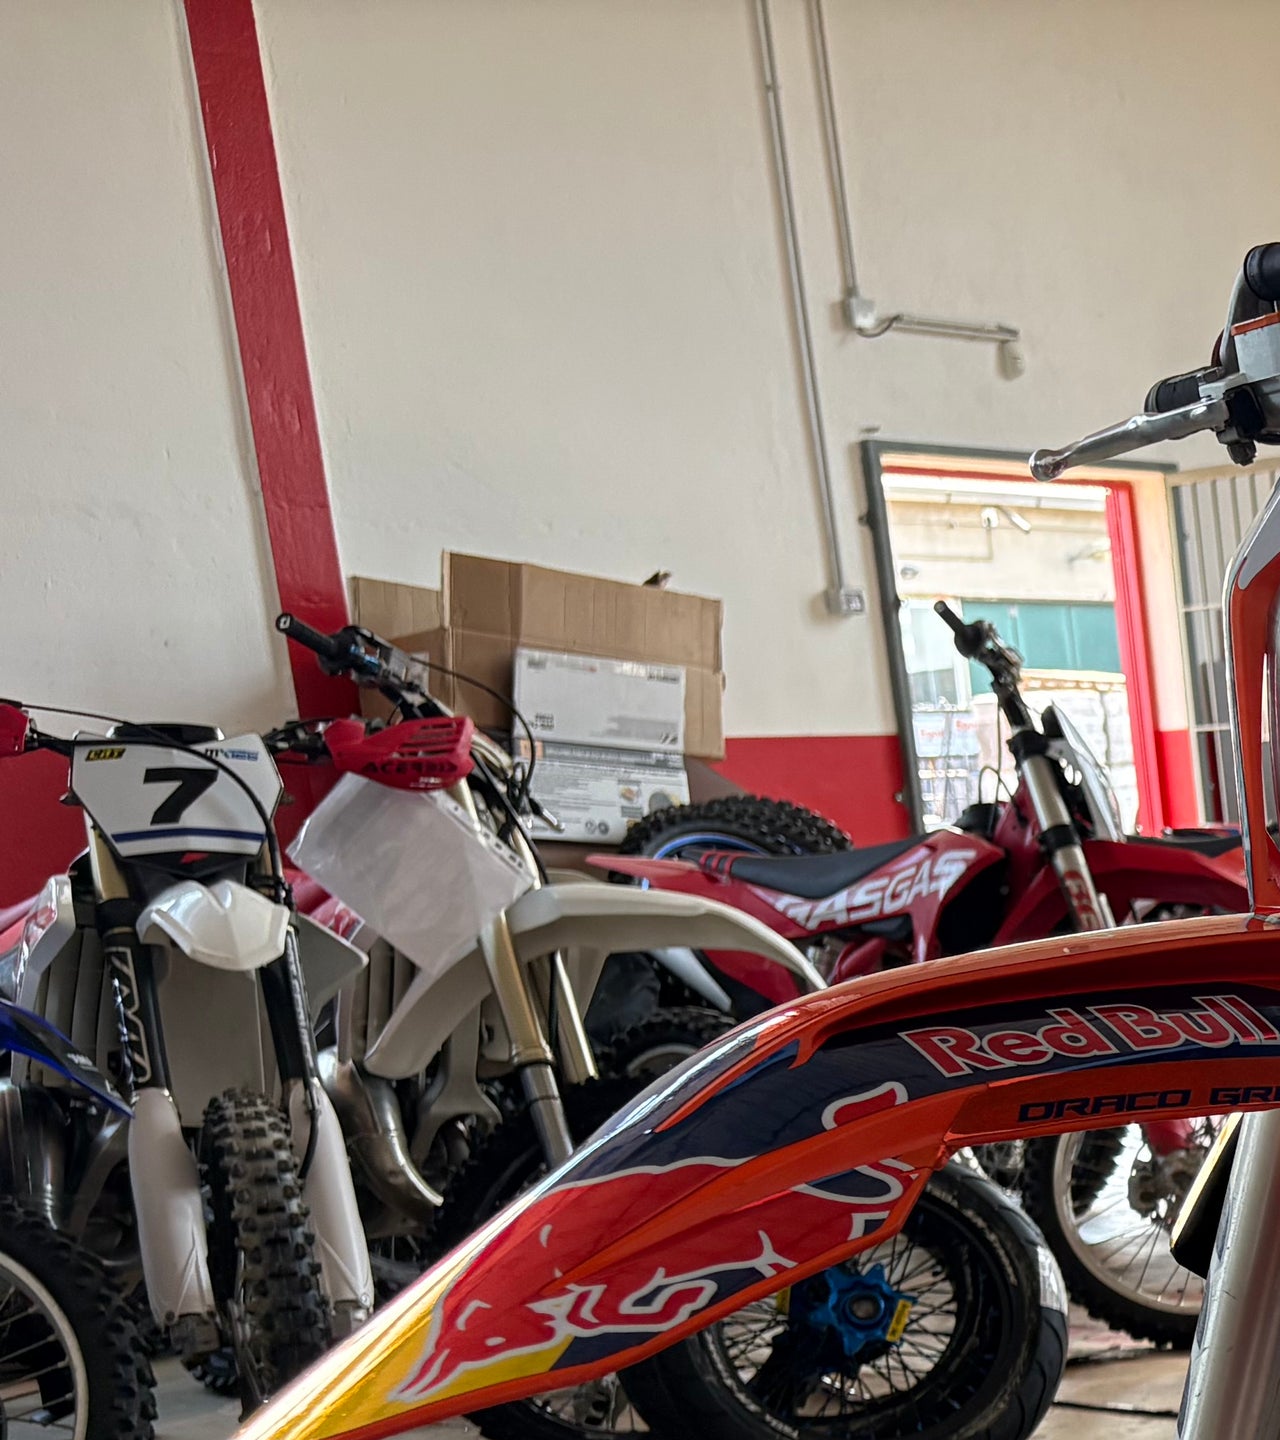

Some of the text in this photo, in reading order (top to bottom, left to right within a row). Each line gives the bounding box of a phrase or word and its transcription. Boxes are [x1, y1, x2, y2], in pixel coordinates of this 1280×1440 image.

[143, 767, 219, 825] 7
[774, 849, 977, 931] GASGAS
[897, 1008, 1121, 1078] Red
[1017, 1088, 1192, 1123] DRACO
